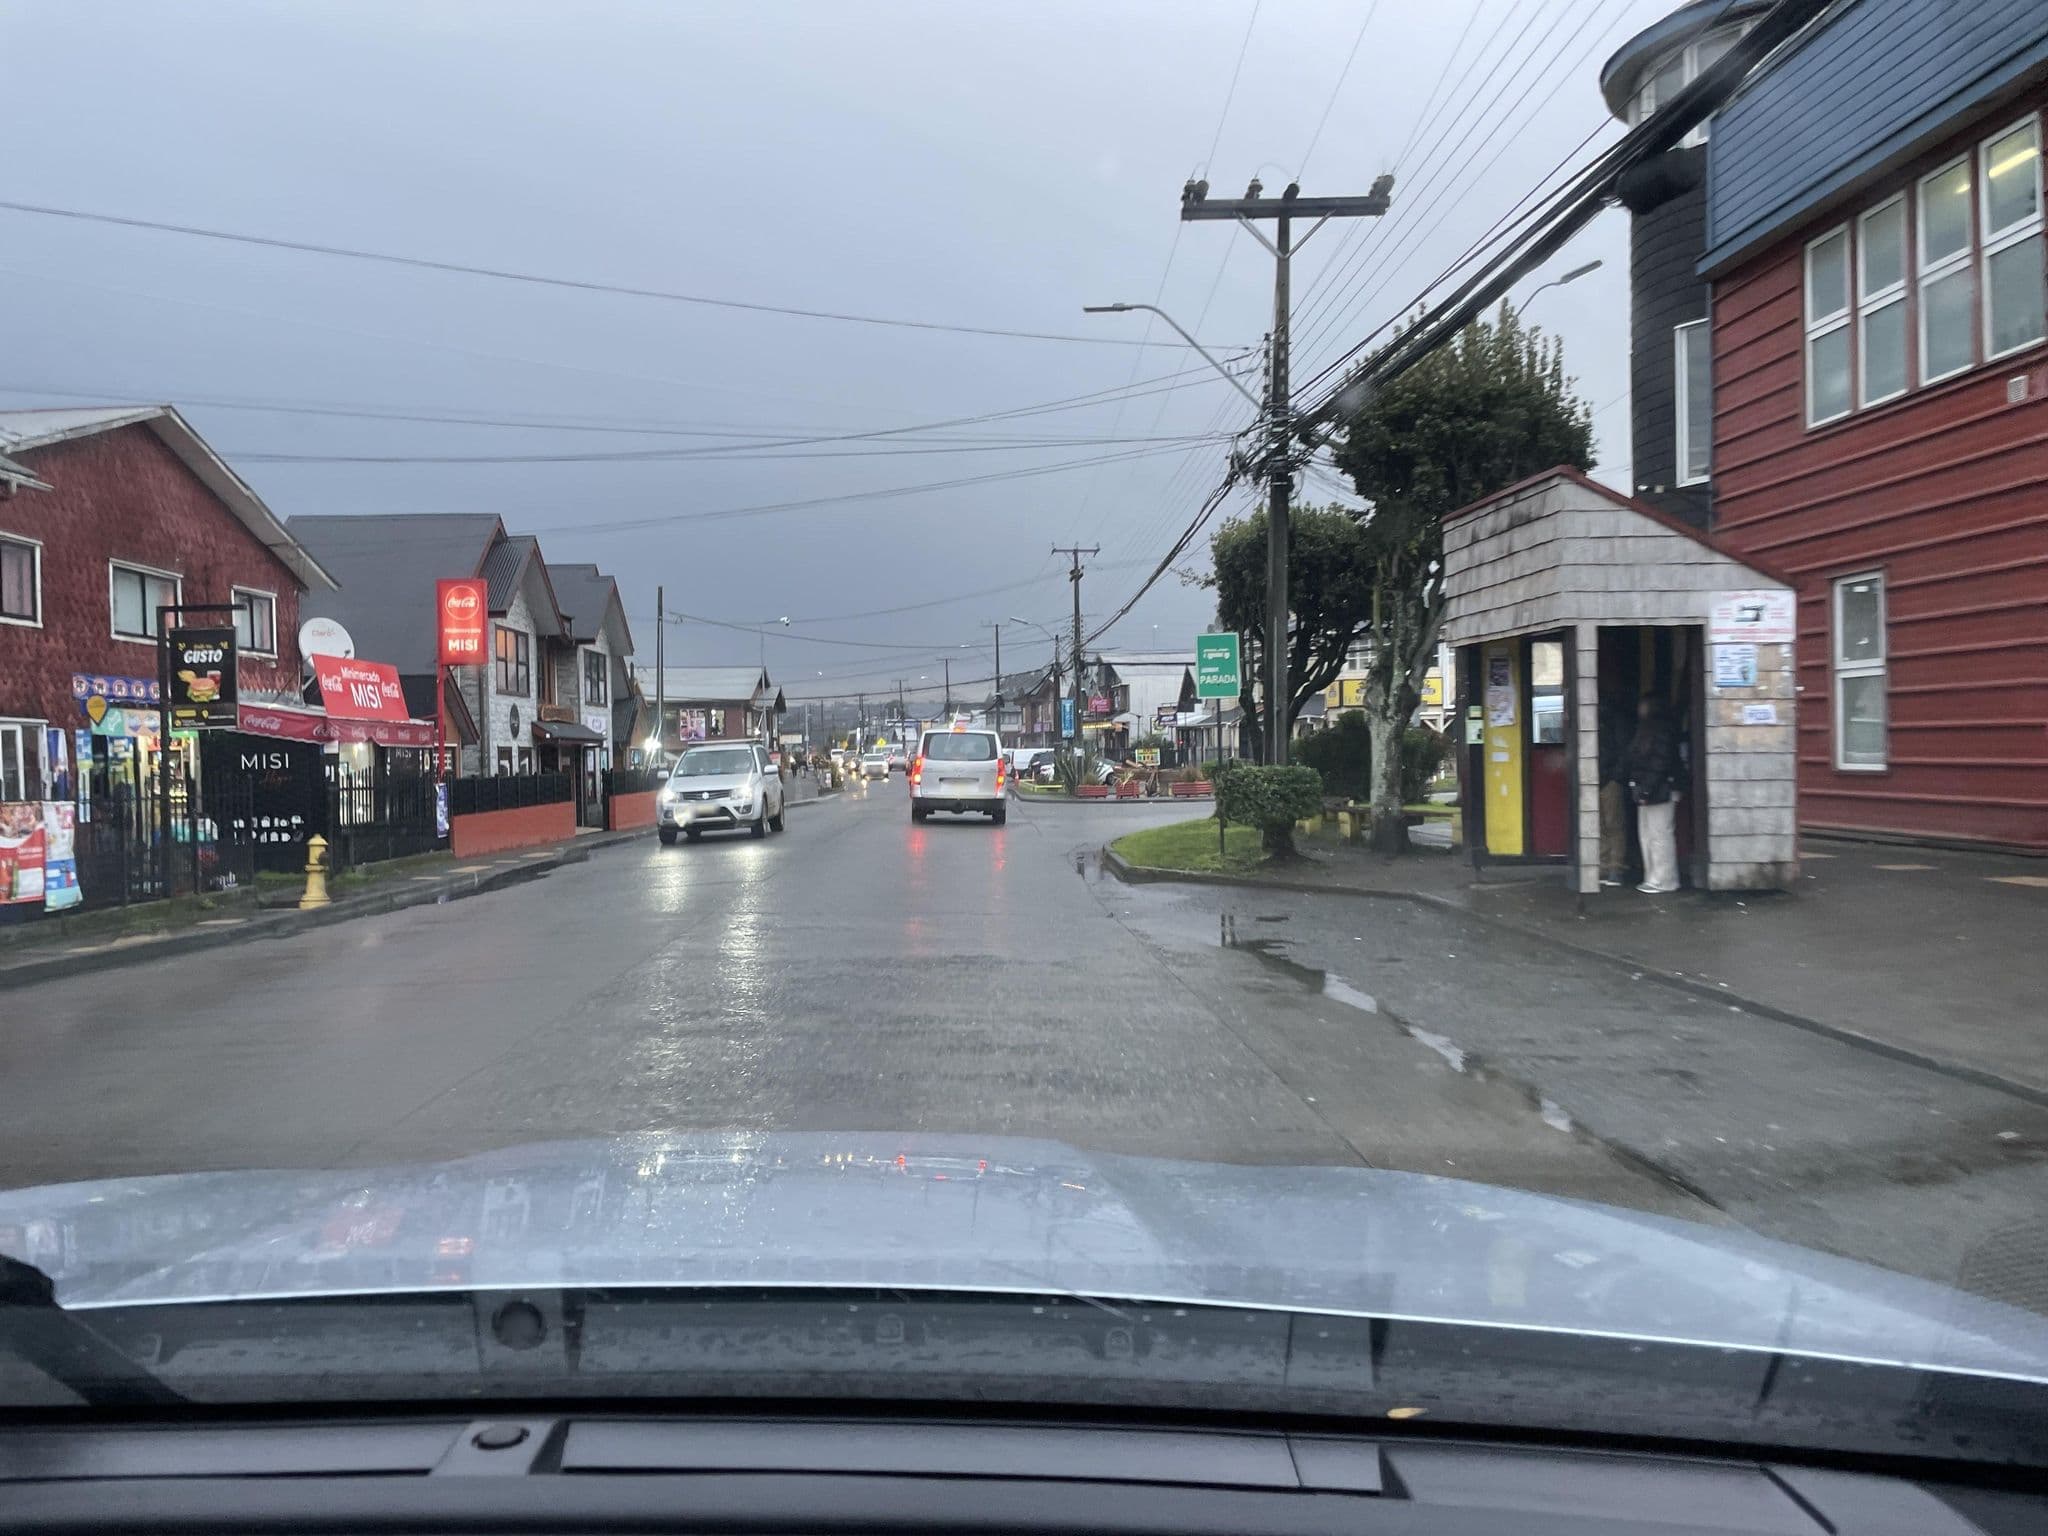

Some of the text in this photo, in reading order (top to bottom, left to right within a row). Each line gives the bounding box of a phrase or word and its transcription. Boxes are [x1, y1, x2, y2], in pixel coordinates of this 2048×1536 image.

[448, 639, 478, 651] MISI
[184, 649, 223, 663] GUSTO
[341, 667, 380, 683] Minimercado
[1200, 675, 1237, 685] PARADA
[350, 683, 383, 709] MISI
[241, 753, 289, 770] MISI
